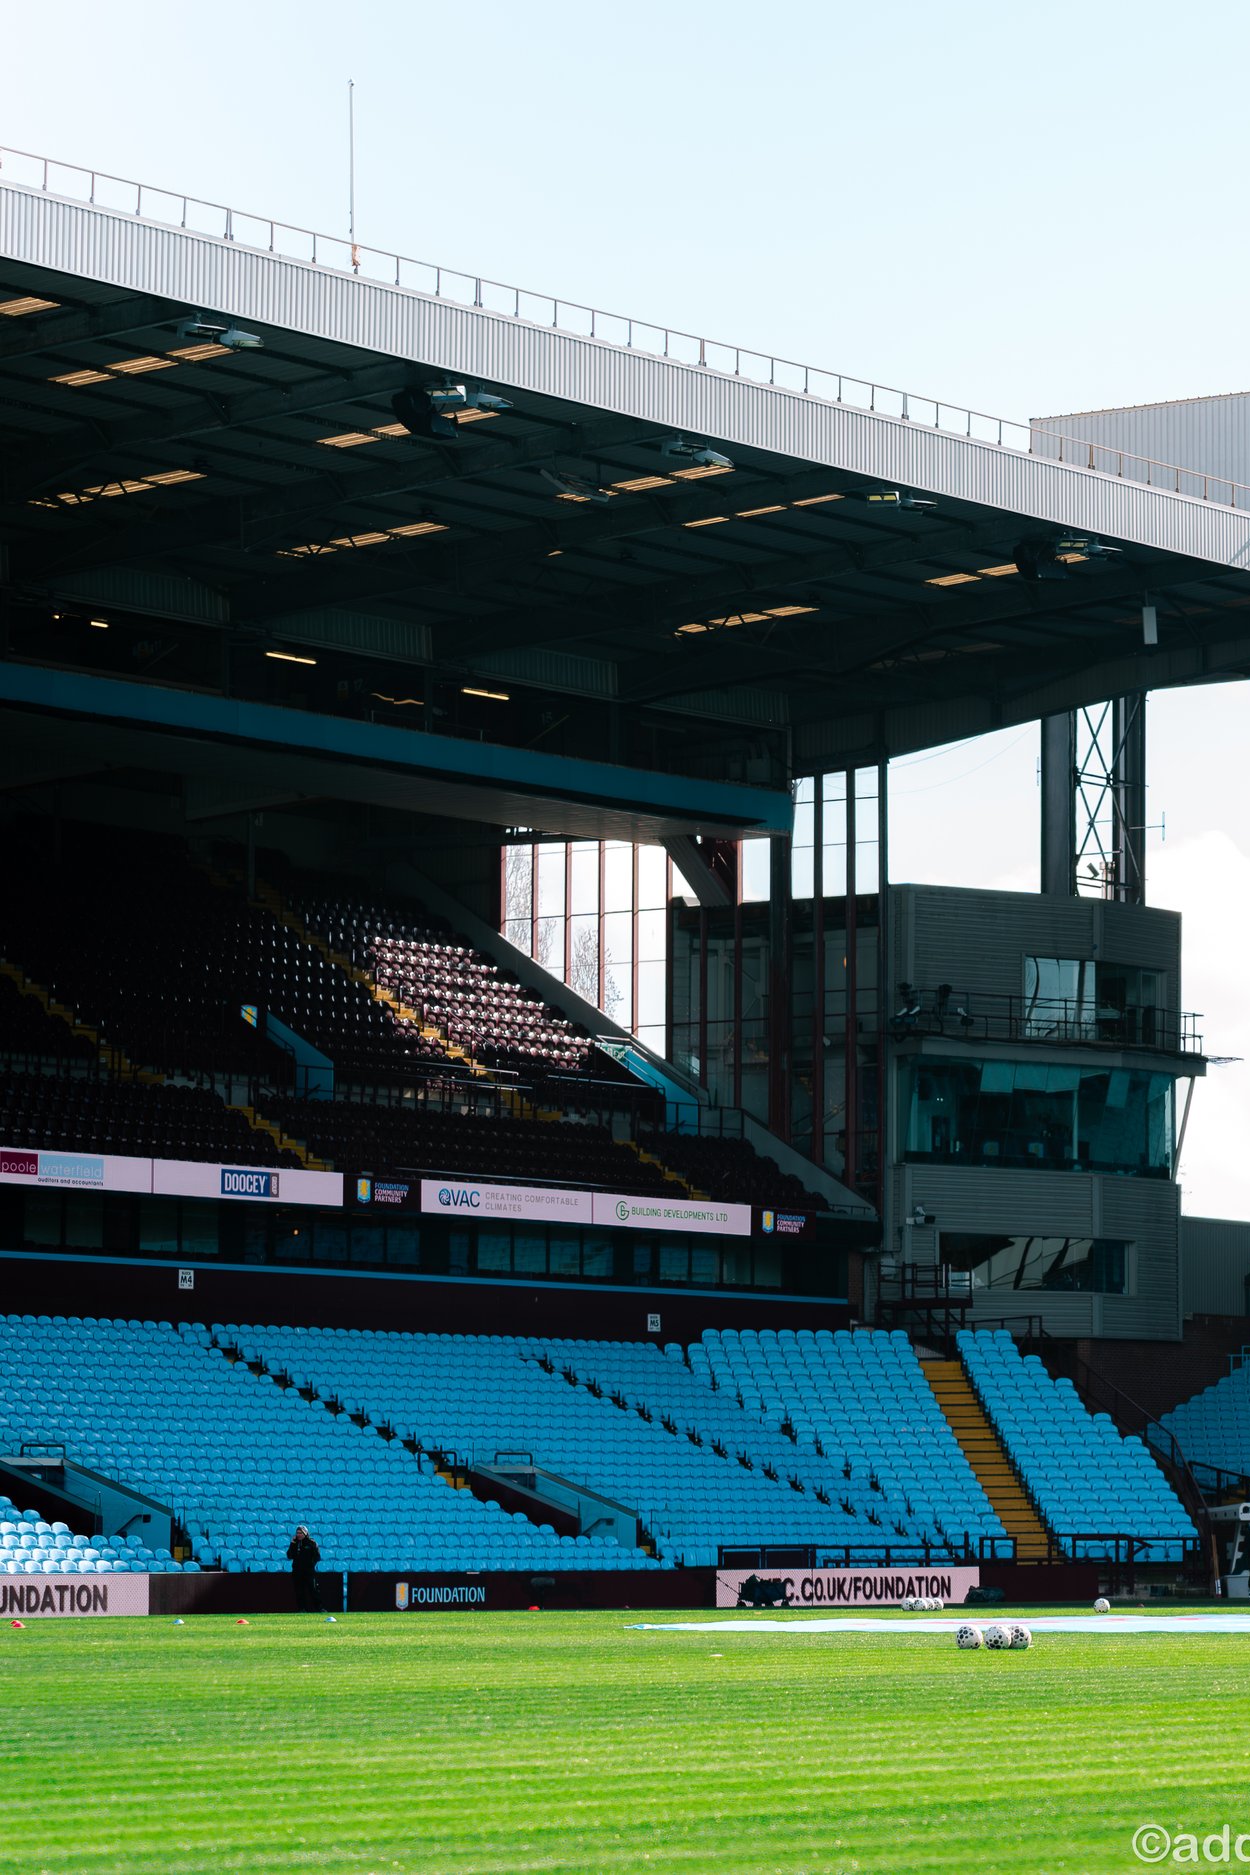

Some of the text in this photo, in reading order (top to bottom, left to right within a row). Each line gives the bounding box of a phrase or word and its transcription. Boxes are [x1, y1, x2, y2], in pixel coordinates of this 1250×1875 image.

[1, 1161, 37, 1174] poole
[41, 1163, 103, 1178] waterfield
[224, 1172, 266, 1194] DOOCEY
[374, 1182, 410, 1191] FOUNDATION
[374, 1189, 408, 1198] COMMUNITY
[374, 1195, 402, 1204] PARTNERS
[438, 1188, 480, 1208] QVAC
[485, 1191, 579, 1206] CREATING COMFORTABLE
[485, 1202, 522, 1212] CLIMATES
[631, 1206, 661, 1217] BUILDING
[663, 1209, 714, 1221] DEVELOPMENTS
[716, 1212, 728, 1222] LTD
[650, 1319, 659, 1327] M5
[411, 1587, 486, 1604] FOUNDATION
